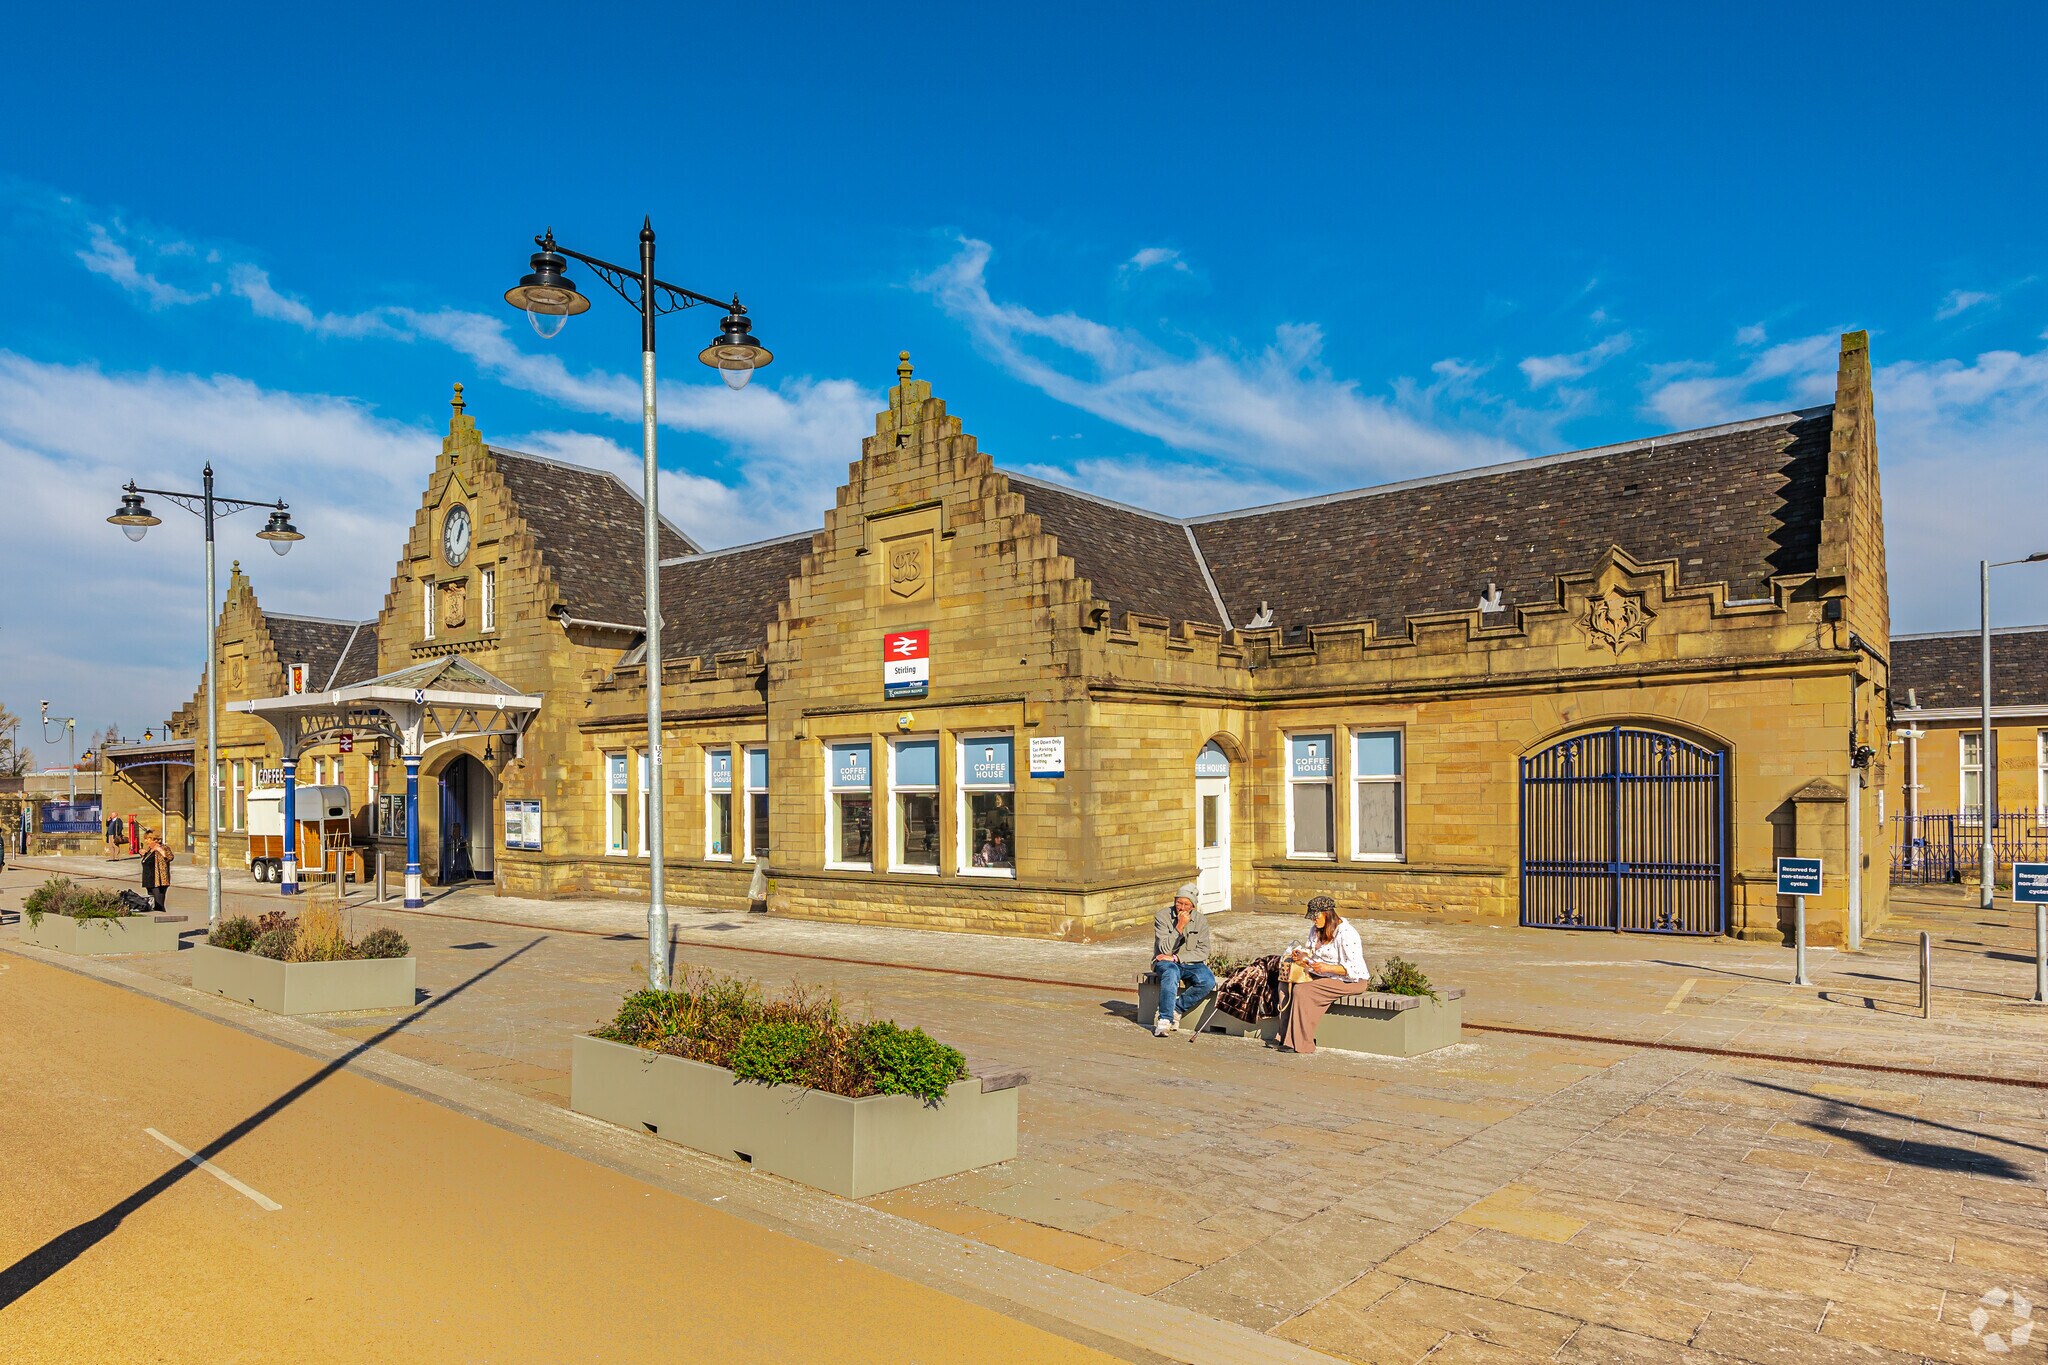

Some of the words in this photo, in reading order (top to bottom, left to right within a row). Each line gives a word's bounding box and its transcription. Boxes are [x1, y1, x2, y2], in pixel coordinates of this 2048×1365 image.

[894, 666, 917, 675] Stirling
[1295, 757, 1330, 765] COFFEE
[1206, 763, 1227, 773] HOUSE
[1297, 764, 1328, 772] HOUSE
[258, 768, 284, 784] COFFEE
[841, 773, 865, 781] HOUSE
[976, 770, 1004, 778] HOUSE
